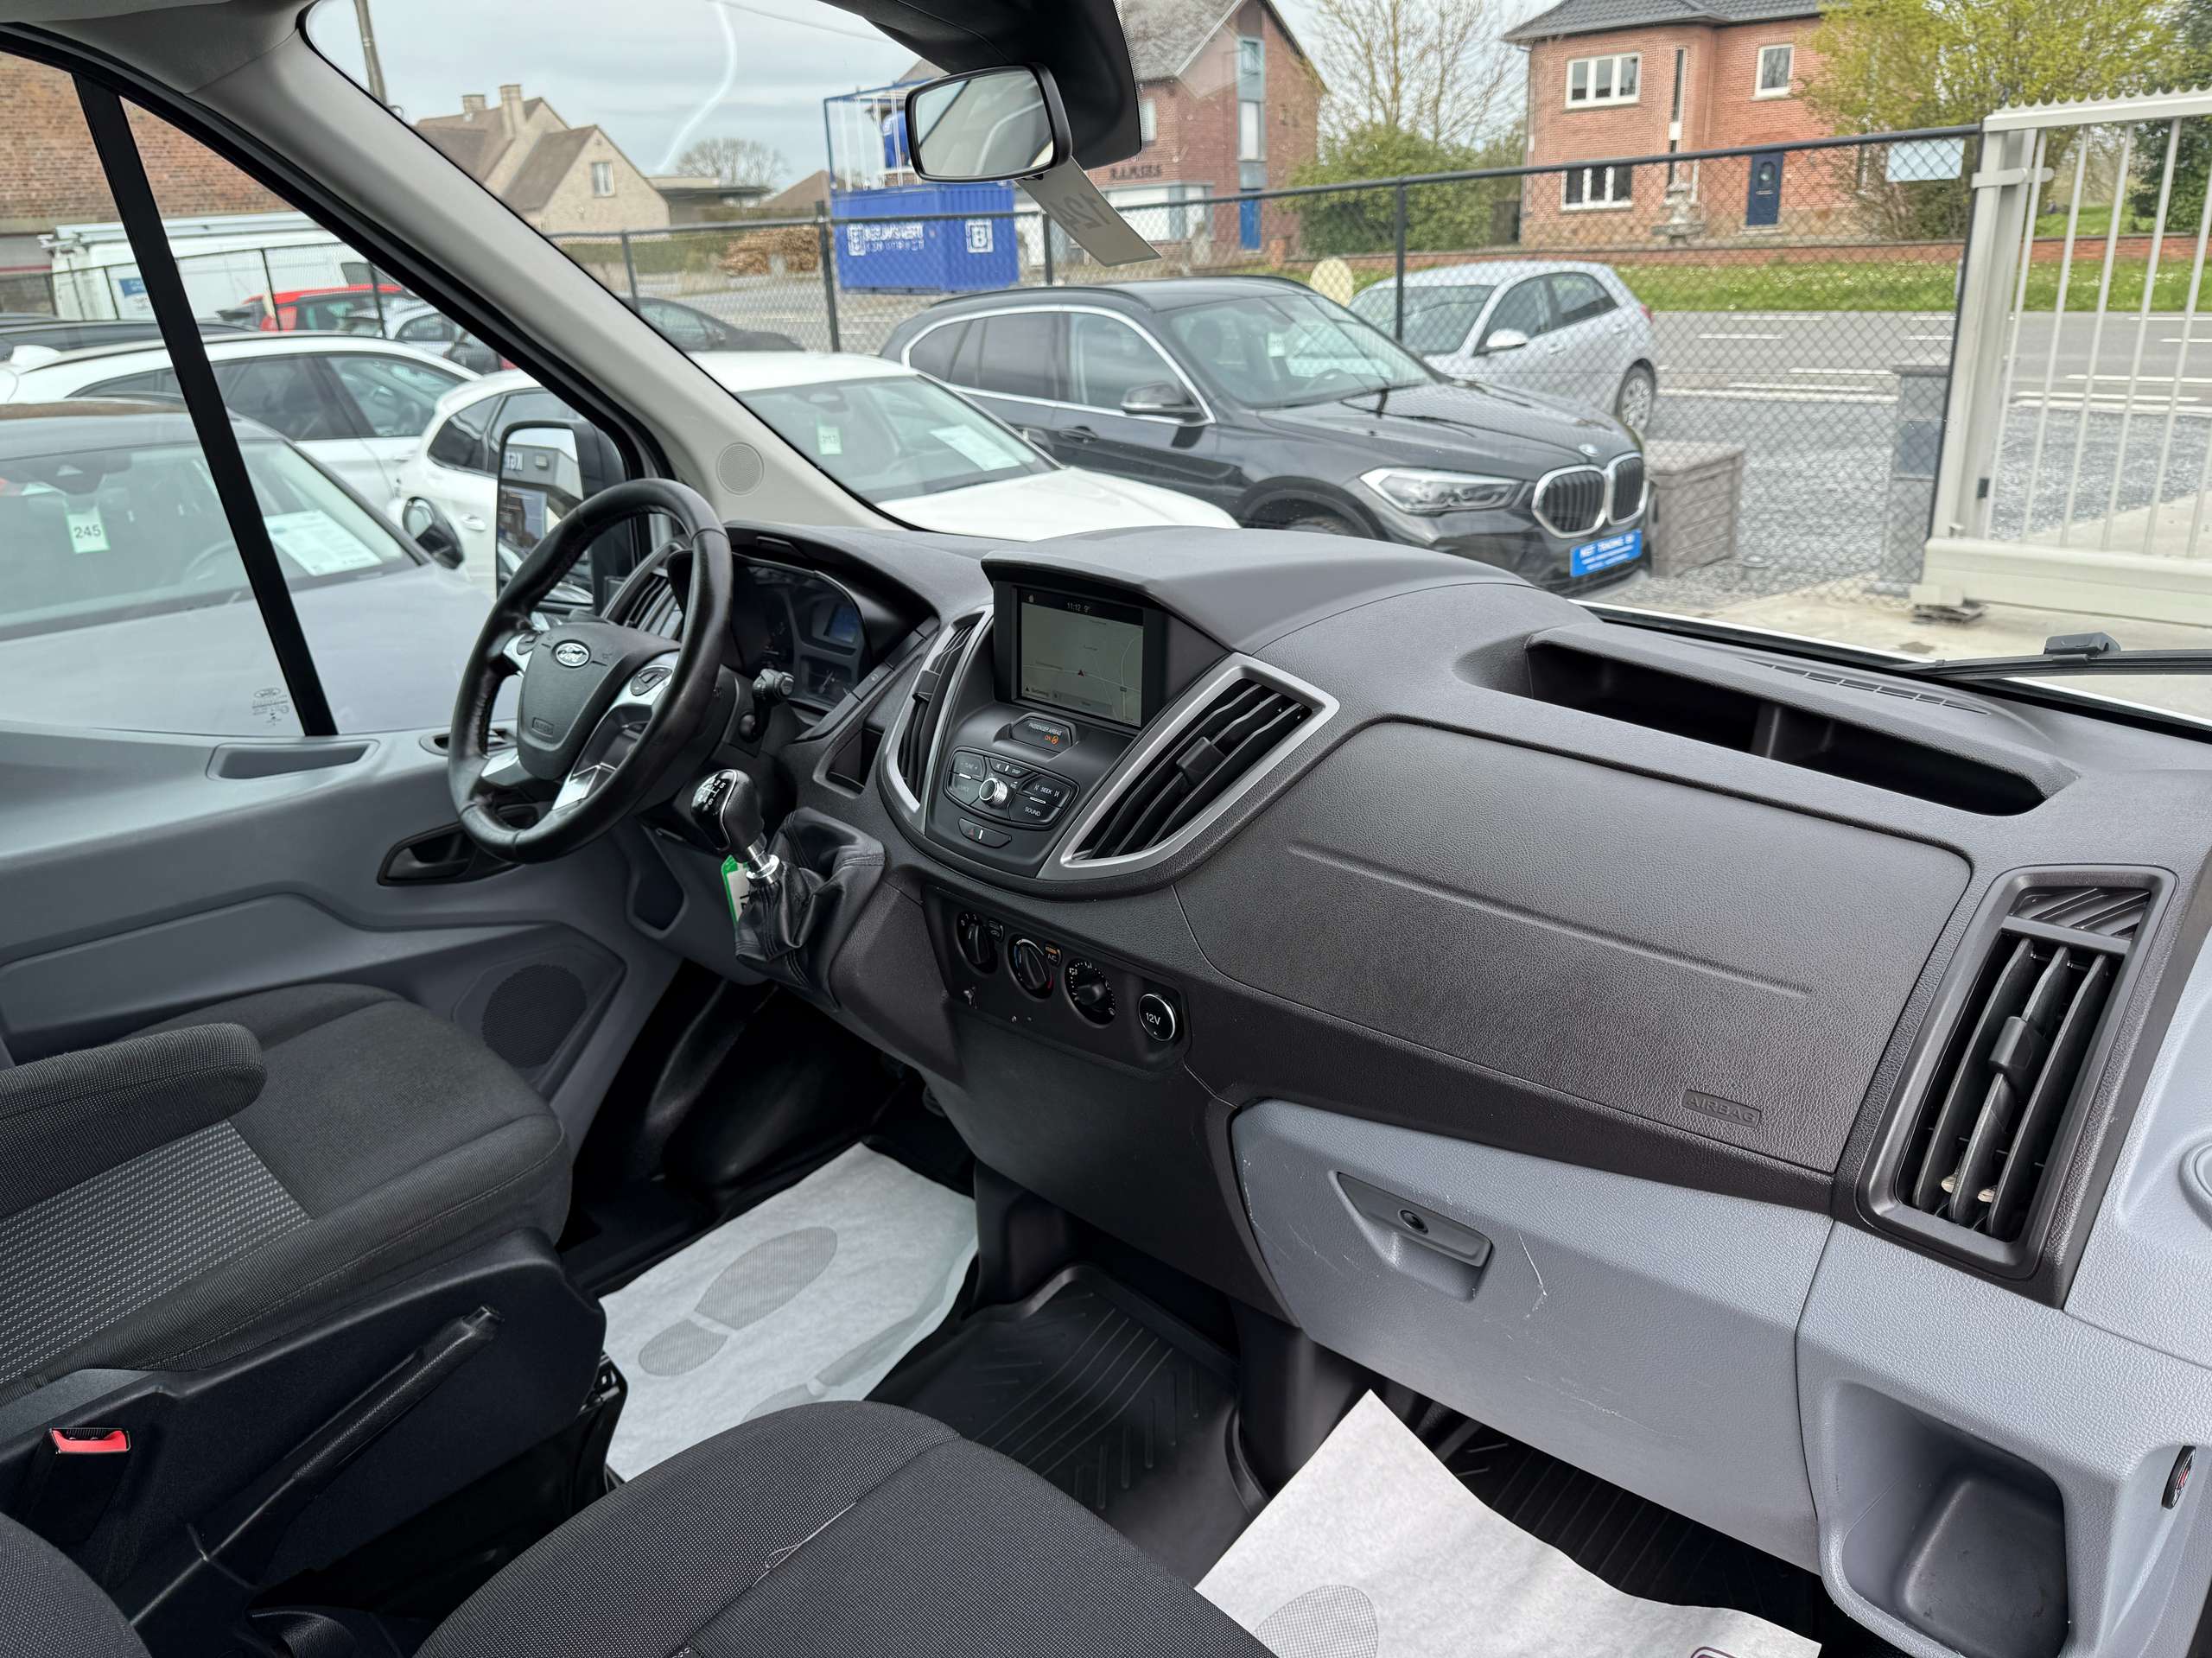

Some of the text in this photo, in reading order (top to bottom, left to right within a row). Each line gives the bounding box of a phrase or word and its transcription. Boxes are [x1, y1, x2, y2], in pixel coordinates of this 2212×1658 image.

[74, 524, 101, 539] 245
[1025, 806, 1041, 816] SOUND
[1146, 1012, 1160, 1026] 12V
[1687, 1095, 1755, 1122] AIRBAG
